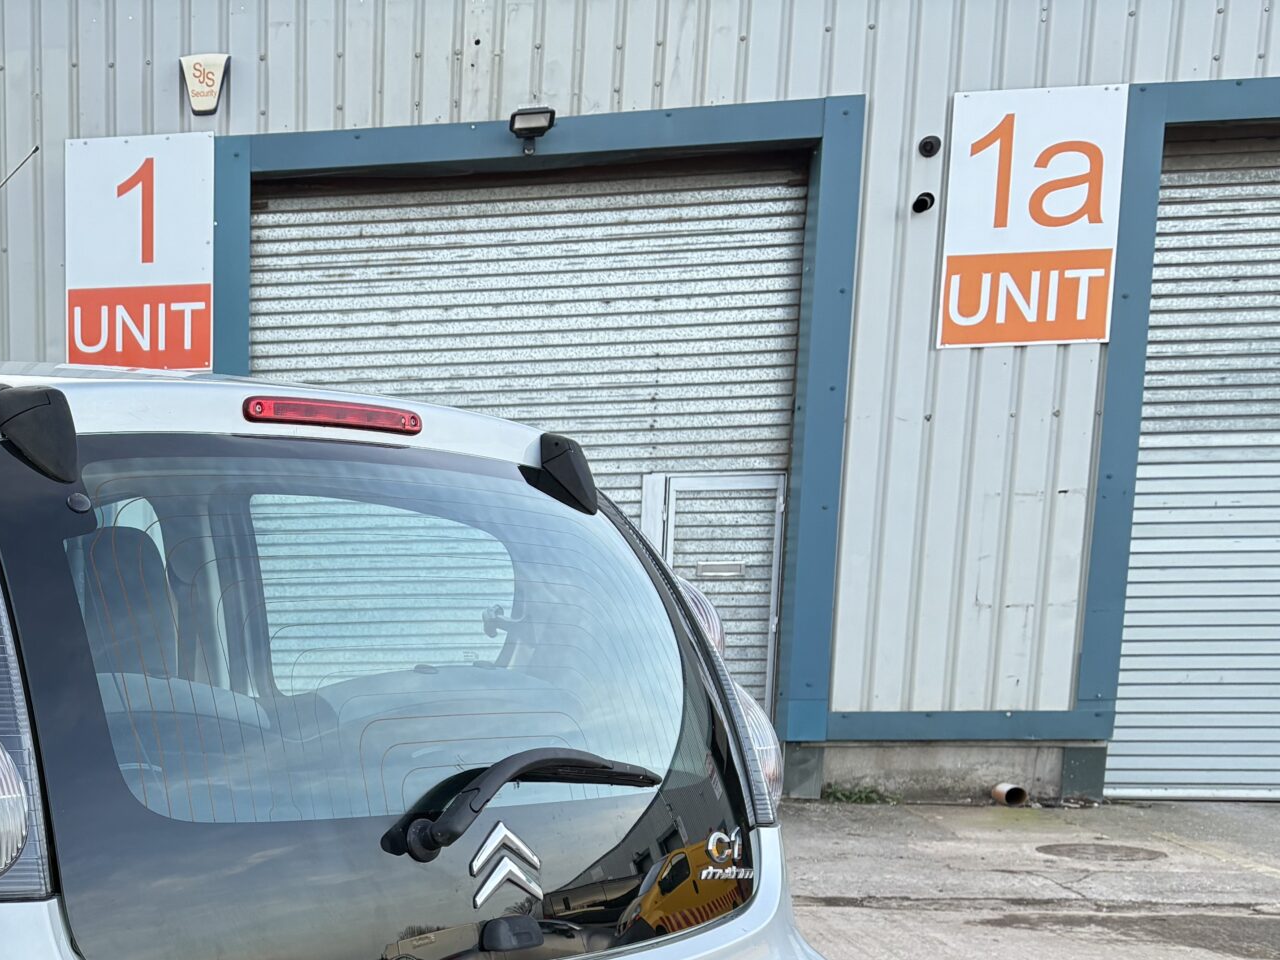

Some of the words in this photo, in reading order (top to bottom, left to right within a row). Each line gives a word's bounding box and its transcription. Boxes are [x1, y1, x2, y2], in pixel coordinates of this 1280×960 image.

[191, 89, 217, 98] Security
[193, 62, 215, 87] SJS
[970, 113, 1104, 228] 1a
[116, 157, 154, 263] 1
[948, 268, 1105, 326] UNIT
[74, 302, 206, 353] UNIT
[707, 826, 741, 863] C1
